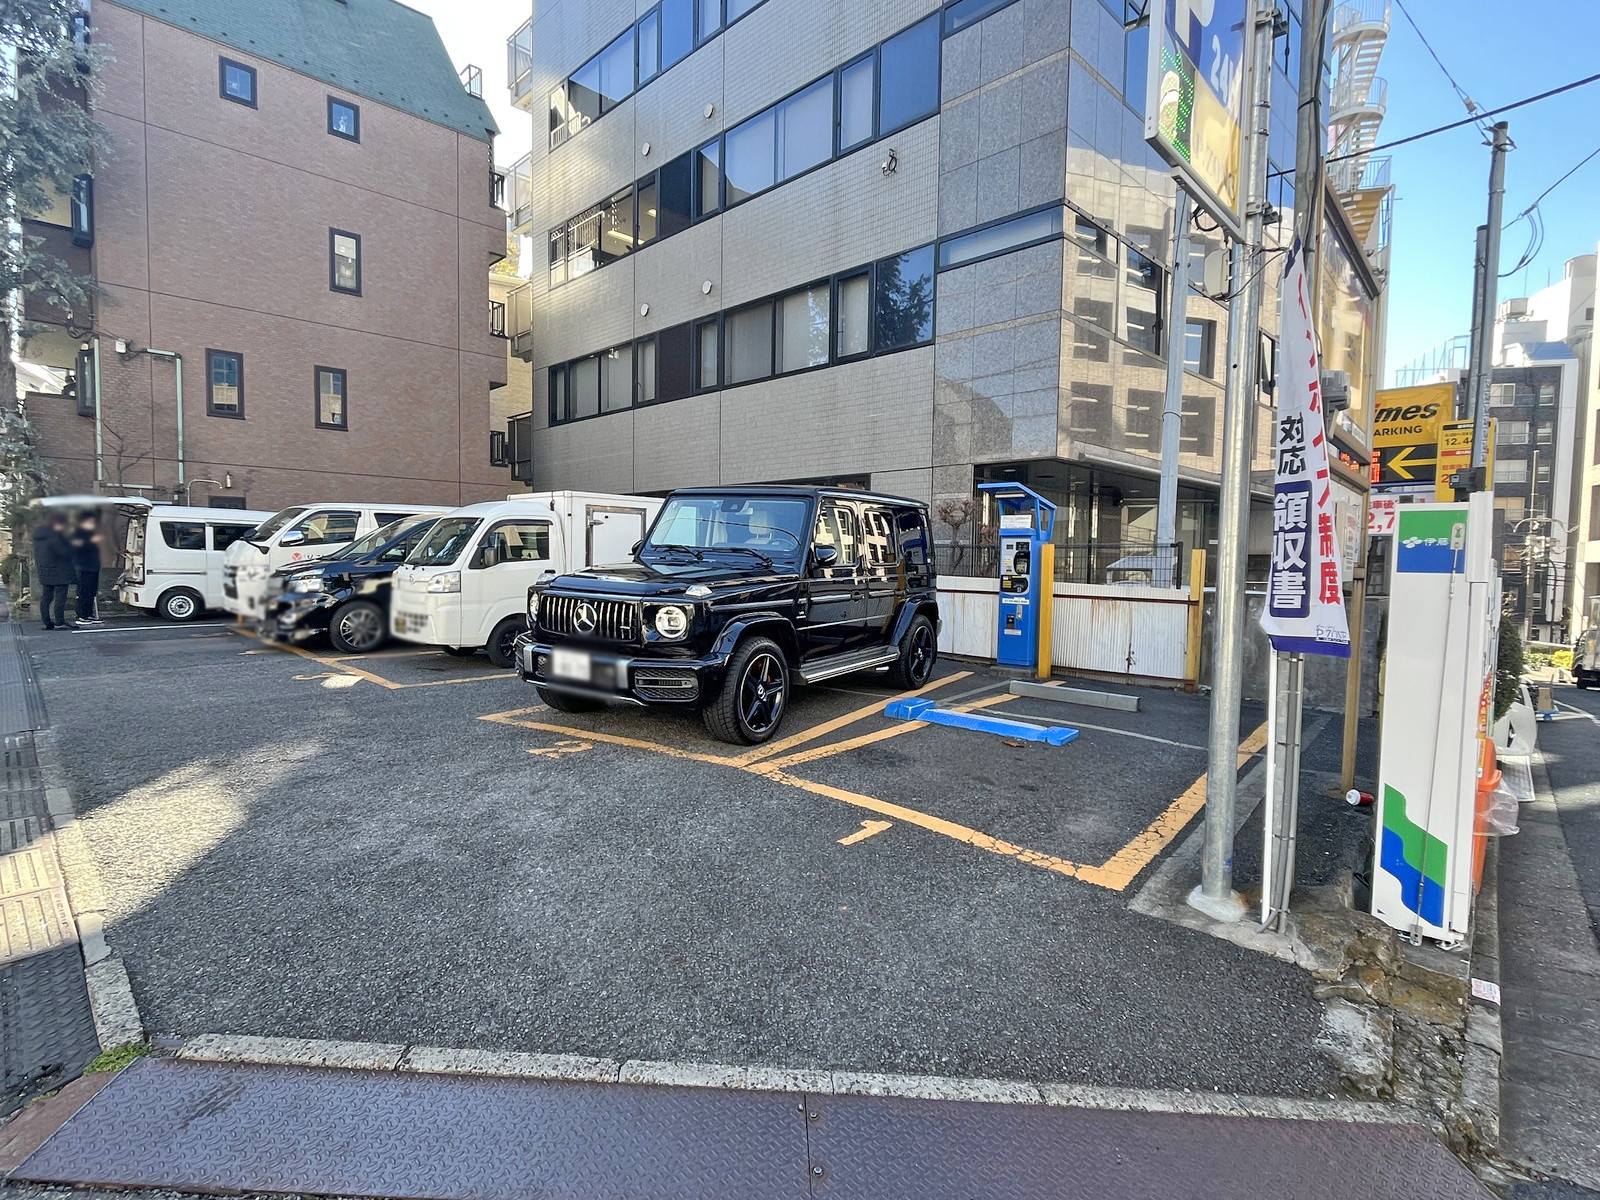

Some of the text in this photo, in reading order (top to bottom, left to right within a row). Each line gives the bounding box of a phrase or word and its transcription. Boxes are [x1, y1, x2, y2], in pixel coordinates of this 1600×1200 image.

[1277, 411, 1306, 477] 対応
[1373, 425, 1423, 436] ARKING
[1368, 511, 1395, 532] 2,7
[1273, 491, 1310, 608] 領収書
